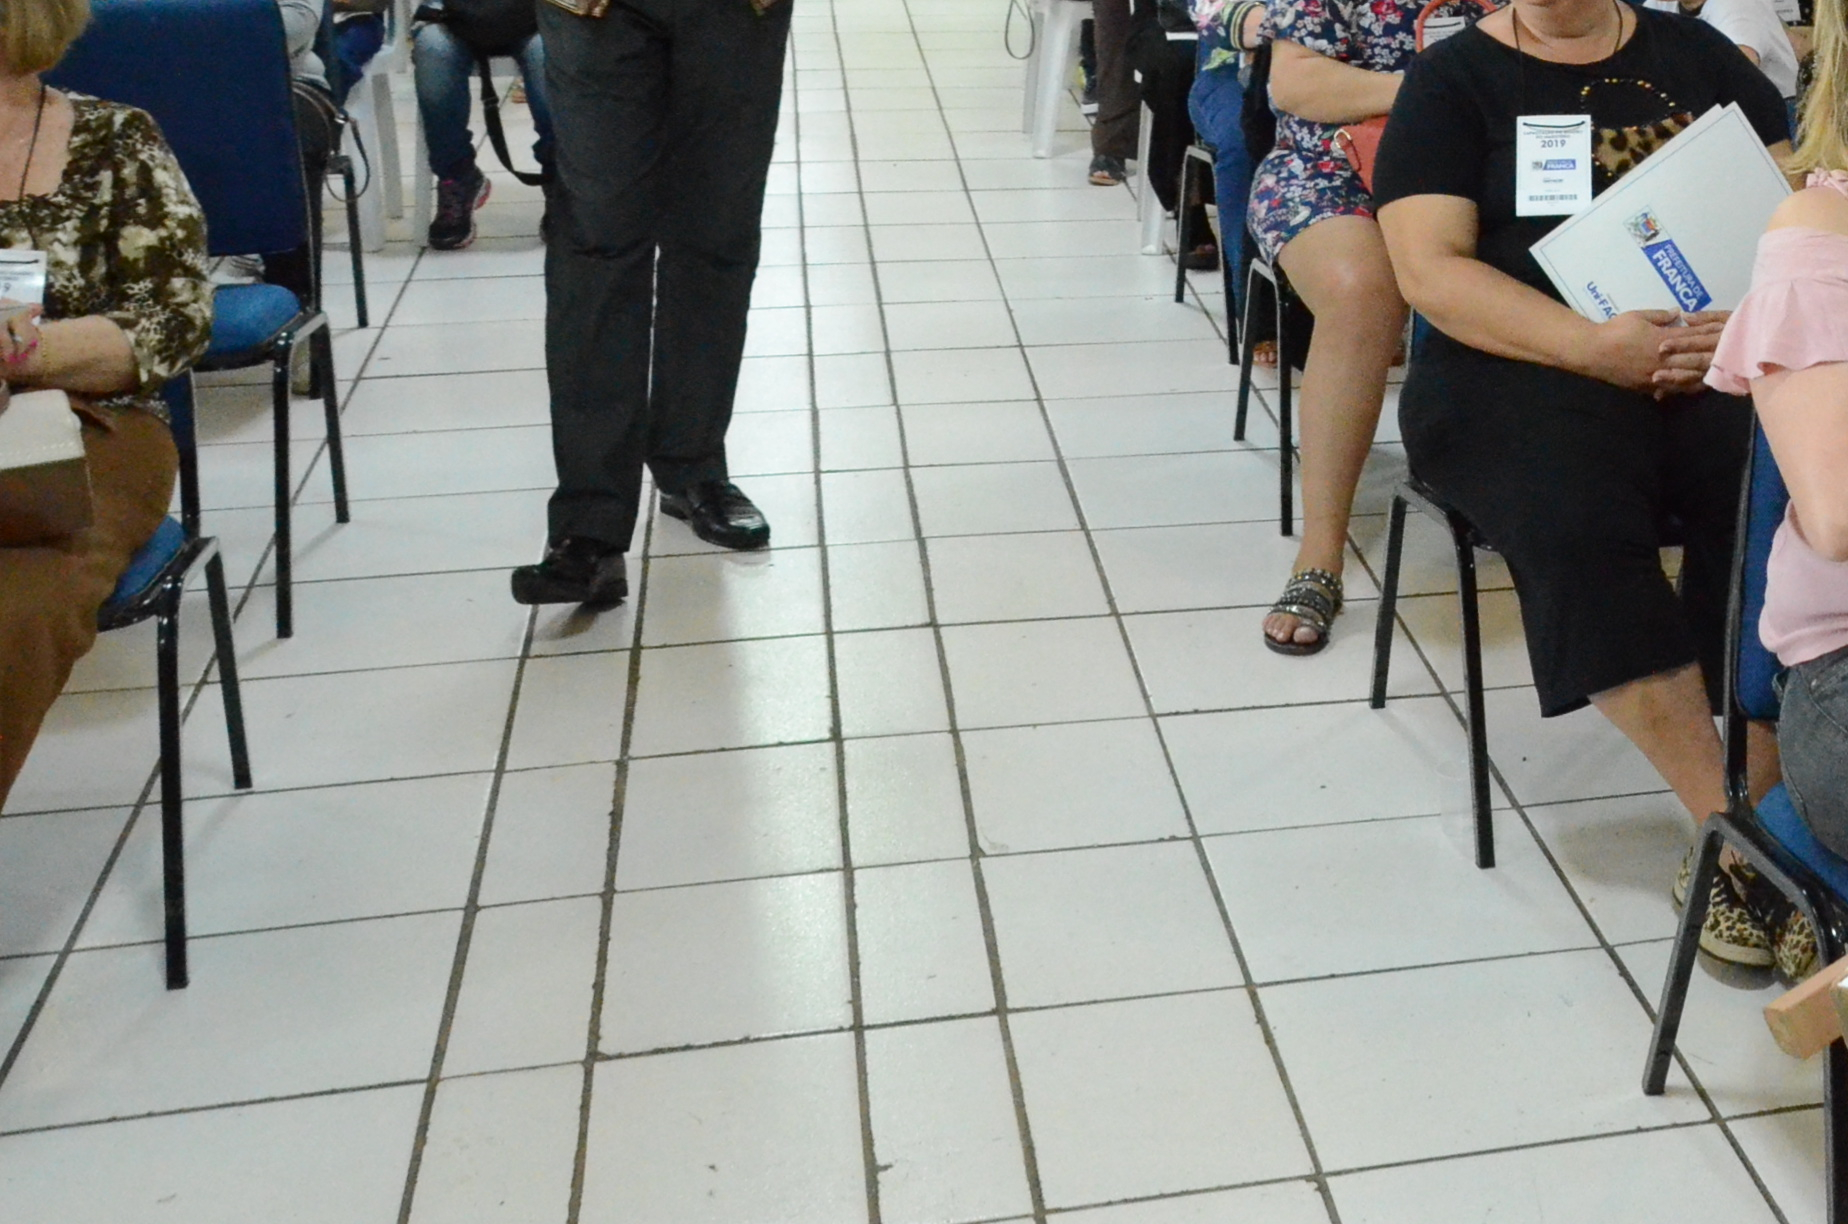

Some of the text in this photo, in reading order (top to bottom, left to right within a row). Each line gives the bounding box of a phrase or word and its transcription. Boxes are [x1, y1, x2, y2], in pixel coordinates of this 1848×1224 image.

[1541, 139, 1566, 148] 2019
[1652, 249, 1698, 312] FRANCA
[1664, 243, 1704, 299] PREFEITURA DE
[1586, 281, 1618, 319] Uni-FAC
